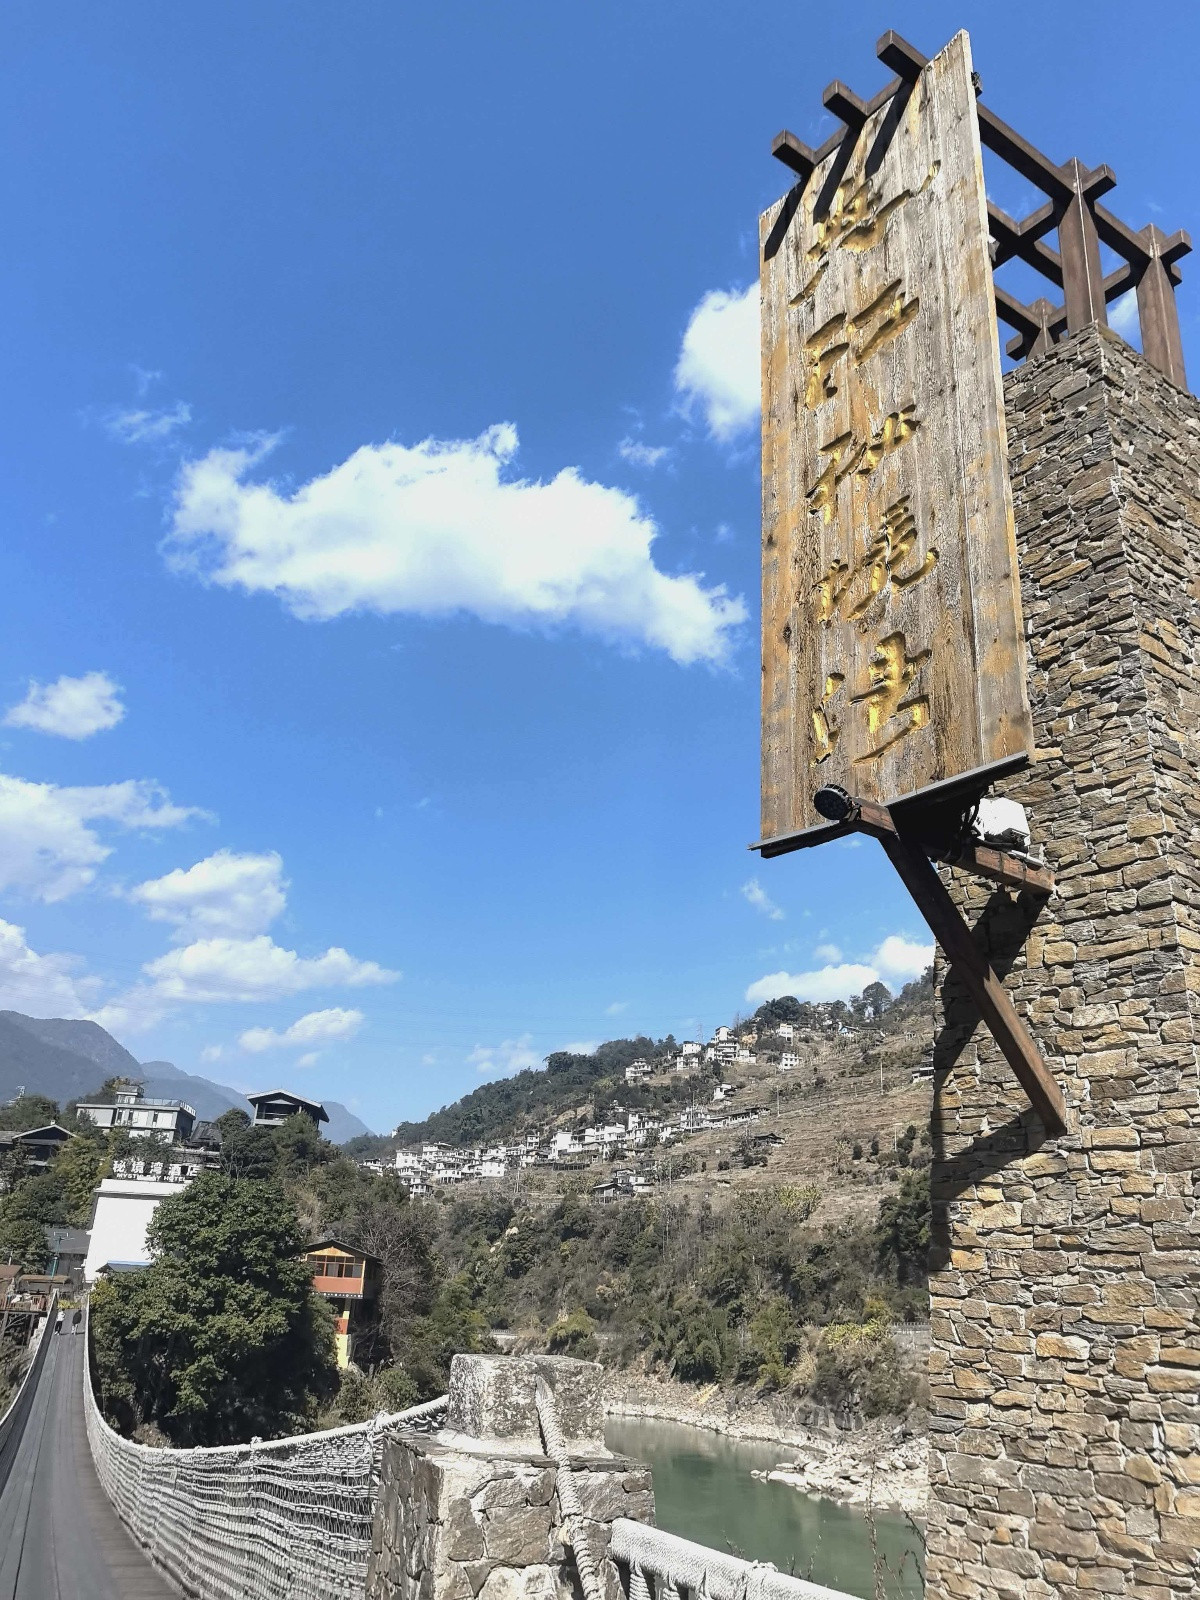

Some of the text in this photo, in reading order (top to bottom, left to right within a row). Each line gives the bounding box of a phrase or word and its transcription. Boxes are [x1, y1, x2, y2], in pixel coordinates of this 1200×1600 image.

[113, 1160, 200, 1177] 秘境湾酒店
[164, 1175, 186, 1183] HOTEL
